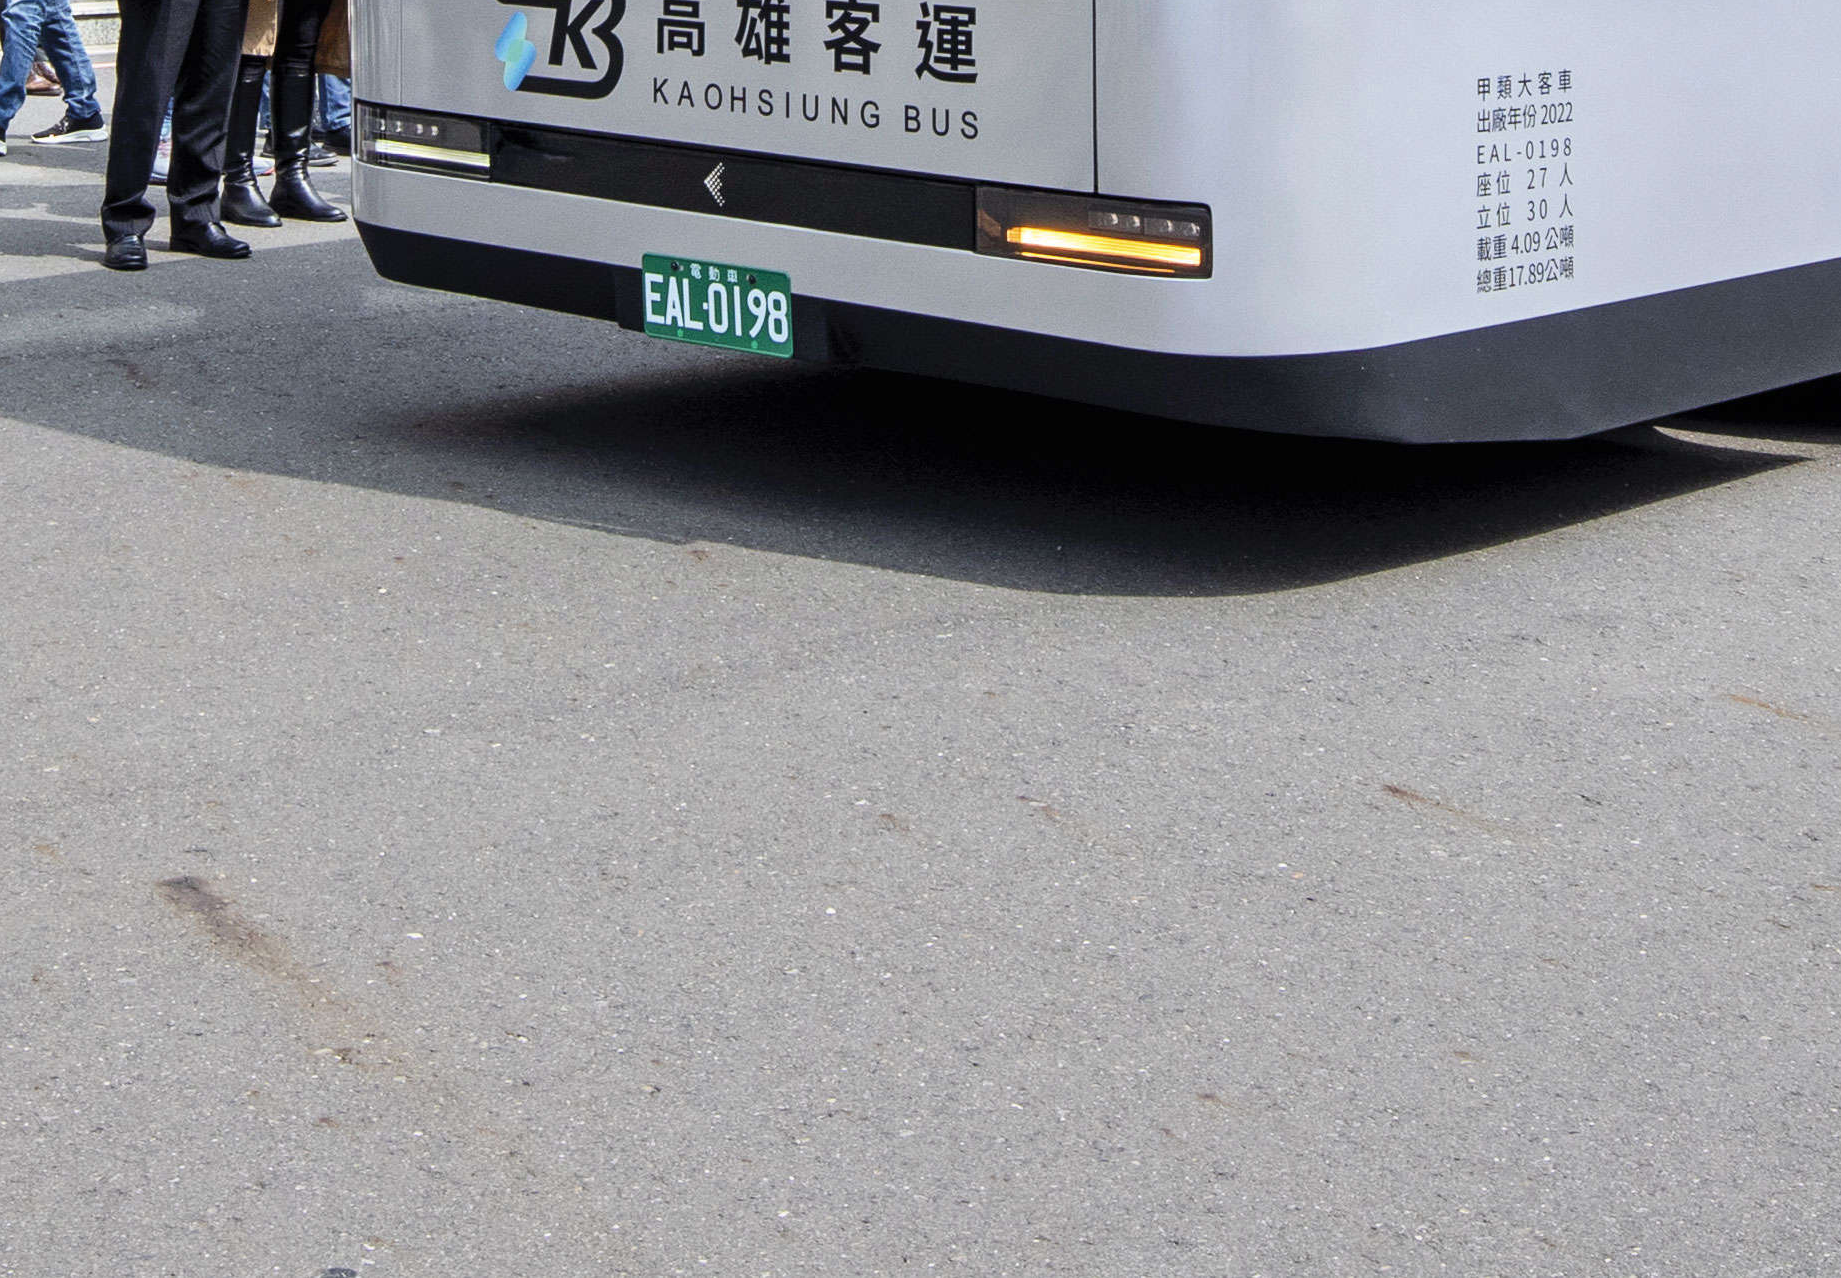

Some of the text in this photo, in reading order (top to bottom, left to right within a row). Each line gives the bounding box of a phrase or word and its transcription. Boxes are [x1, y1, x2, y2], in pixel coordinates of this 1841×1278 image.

[1477, 68, 1572, 102] 甲類大客車
[652, 77, 981, 141] KAOHSIUNG BUS
[1477, 101, 1573, 133] 出廠年份 2022
[1477, 137, 1572, 165] EAL-0198
[1476, 162, 1573, 197] 座位 27 人
[1476, 193, 1573, 229] 立位 30 人
[1510, 231, 1541, 255] 4.09
[689, 263, 739, 284] 電動車
[644, 271, 789, 344] EAL-0198
